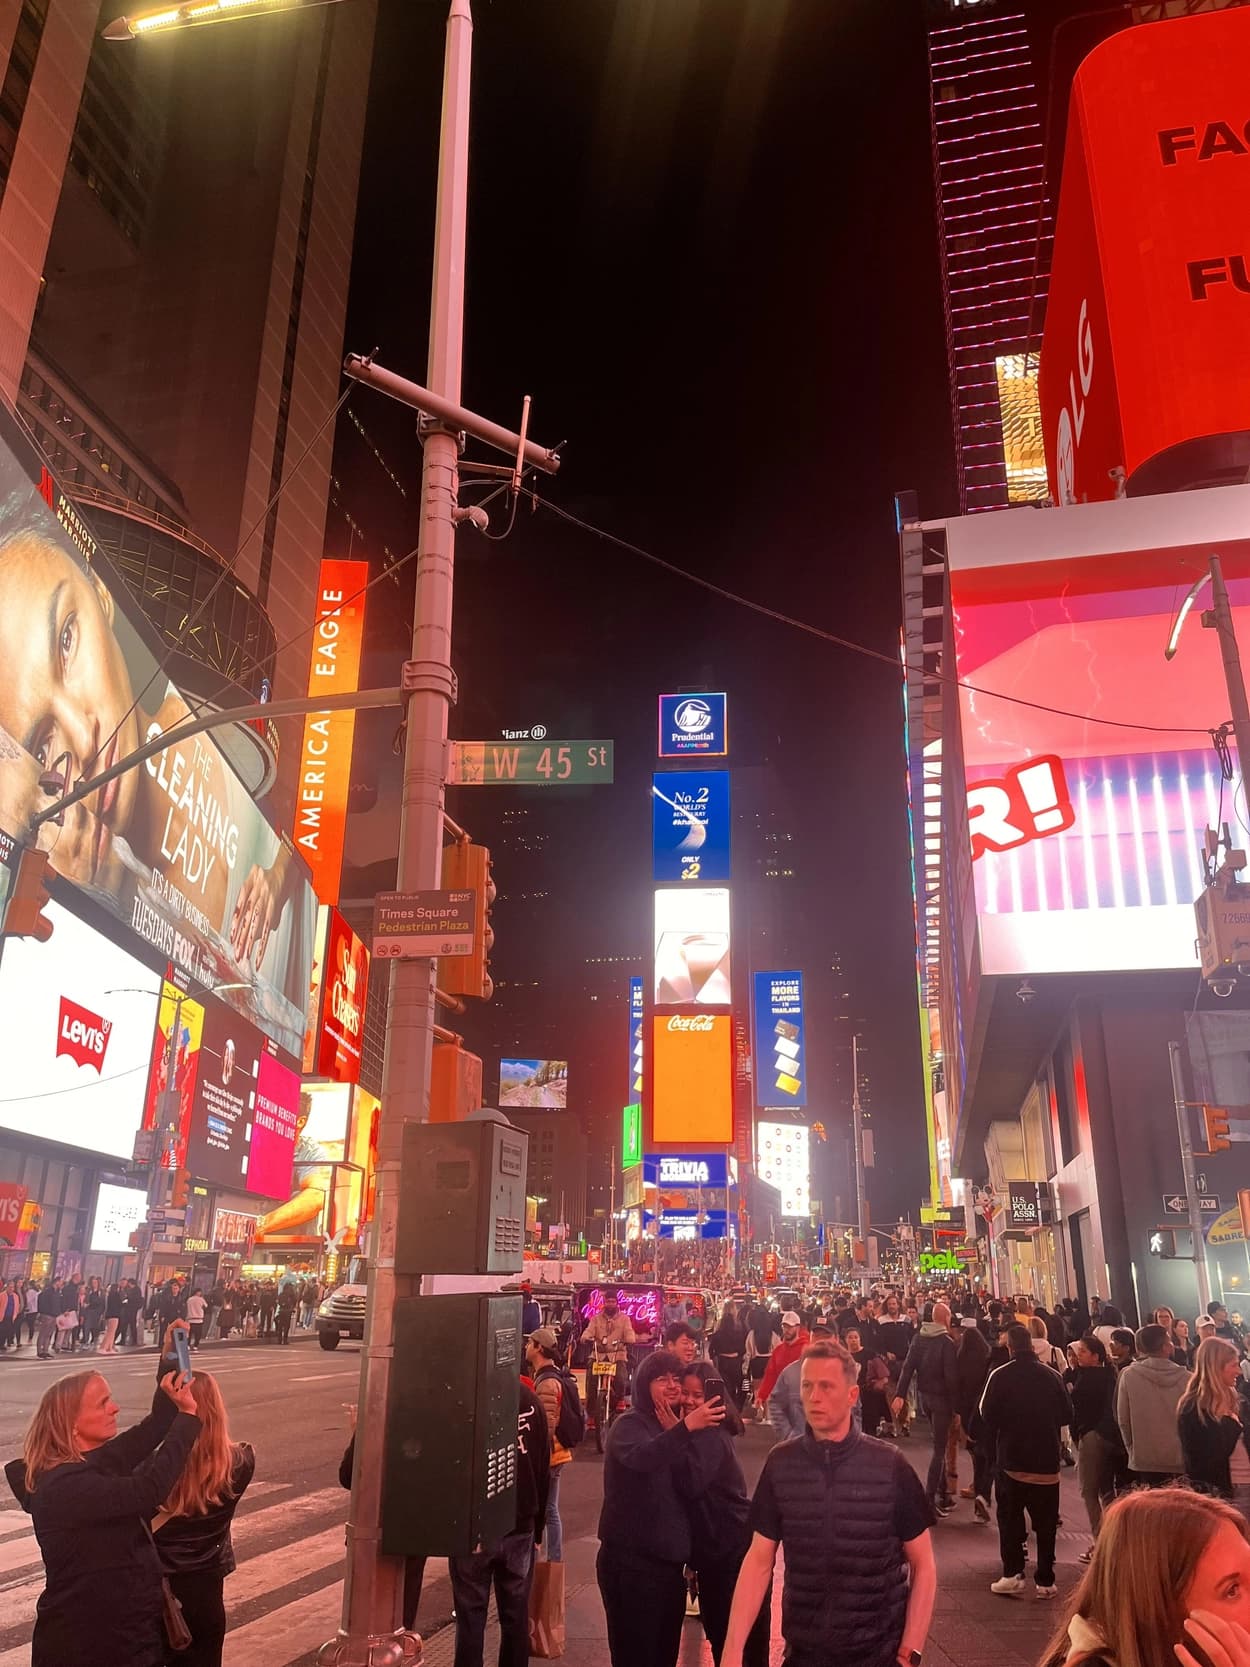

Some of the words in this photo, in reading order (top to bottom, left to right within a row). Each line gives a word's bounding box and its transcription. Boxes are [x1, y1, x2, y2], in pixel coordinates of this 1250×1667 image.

[59, 495, 97, 554] MARRIOTT
[315, 588, 342, 676] EAGLE
[671, 731, 714, 742] Prudential
[192, 737, 213, 782] THE
[493, 748, 520, 779] W
[535, 747, 572, 779] 45
[587, 746, 607, 767] St
[144, 721, 240, 871] CLEANING
[695, 787, 709, 803] 2
[160, 806, 216, 896] LADY
[681, 855, 700, 864] ONLY
[681, 862, 701, 881] $2
[379, 908, 414, 920] Times
[416, 907, 459, 921] Square
[131, 895, 174, 956] TUESDAYS
[172, 930, 195, 973] FOX
[378, 922, 438, 934] Pedestrian
[439, 920, 469, 931] Plaza
[771, 986, 799, 995] MORE
[661, 1161, 709, 1175] TRIVIA
[1012, 1203, 1035, 1211] POLO
[1013, 1210, 1037, 1218] ASSN.
